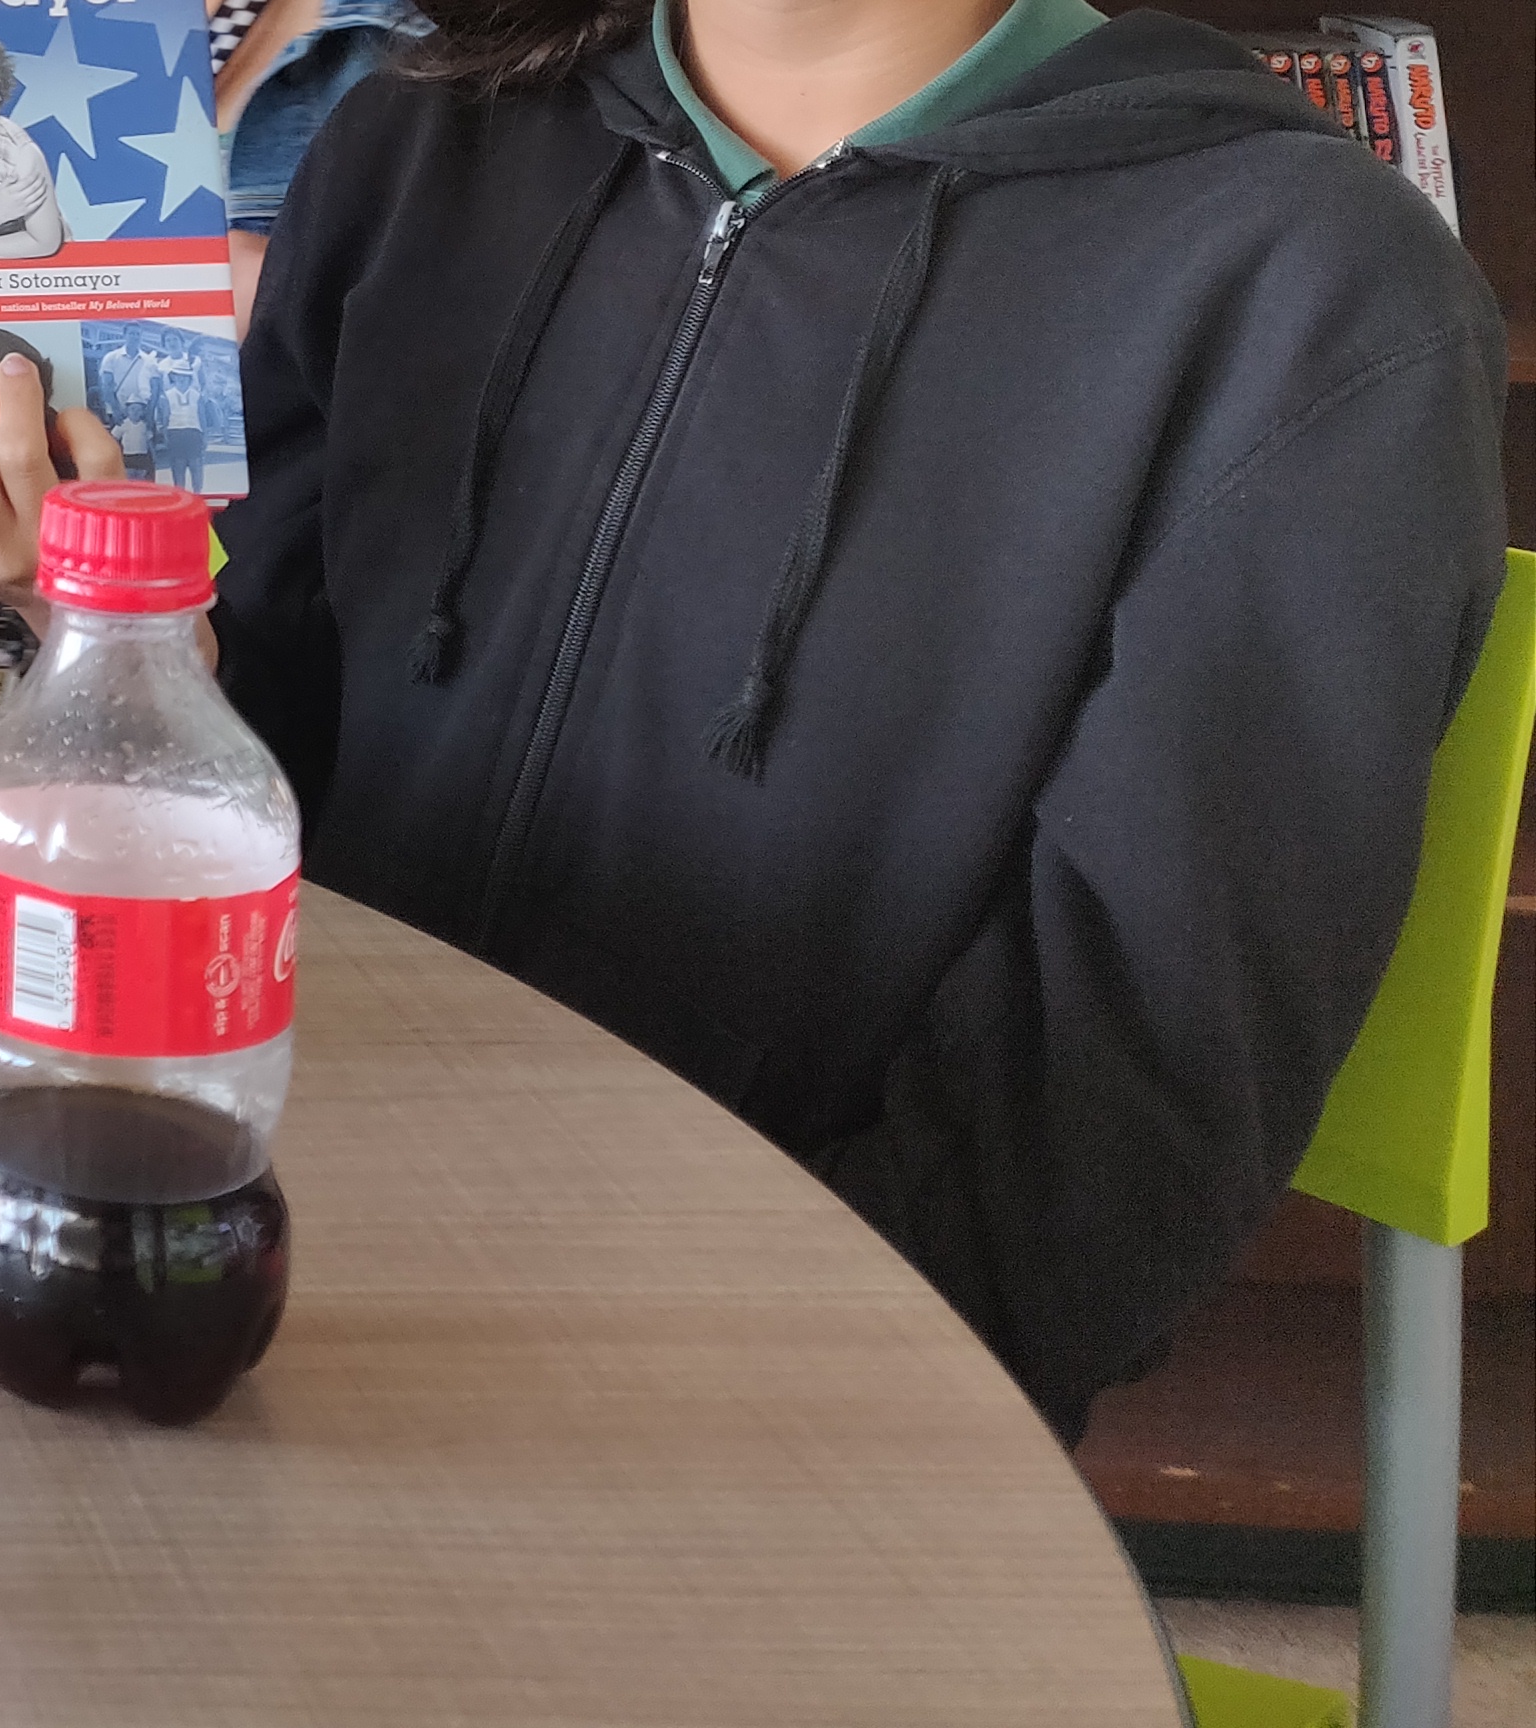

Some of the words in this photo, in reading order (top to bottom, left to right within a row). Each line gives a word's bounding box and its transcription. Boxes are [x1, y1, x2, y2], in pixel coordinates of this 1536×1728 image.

[1367, 77, 1390, 135] NARUTO
[1407, 63, 1437, 130] NARUTO
[9, 273, 121, 291] Sotomayor
[1, 303, 40, 312] national
[41, 302, 86, 311] bestseller
[89, 301, 104, 312] My
[105, 300, 140, 310] Beloved
[143, 299, 171, 309] World
[219, 914, 232, 953] scan
[215, 1010, 230, 1036] sip
